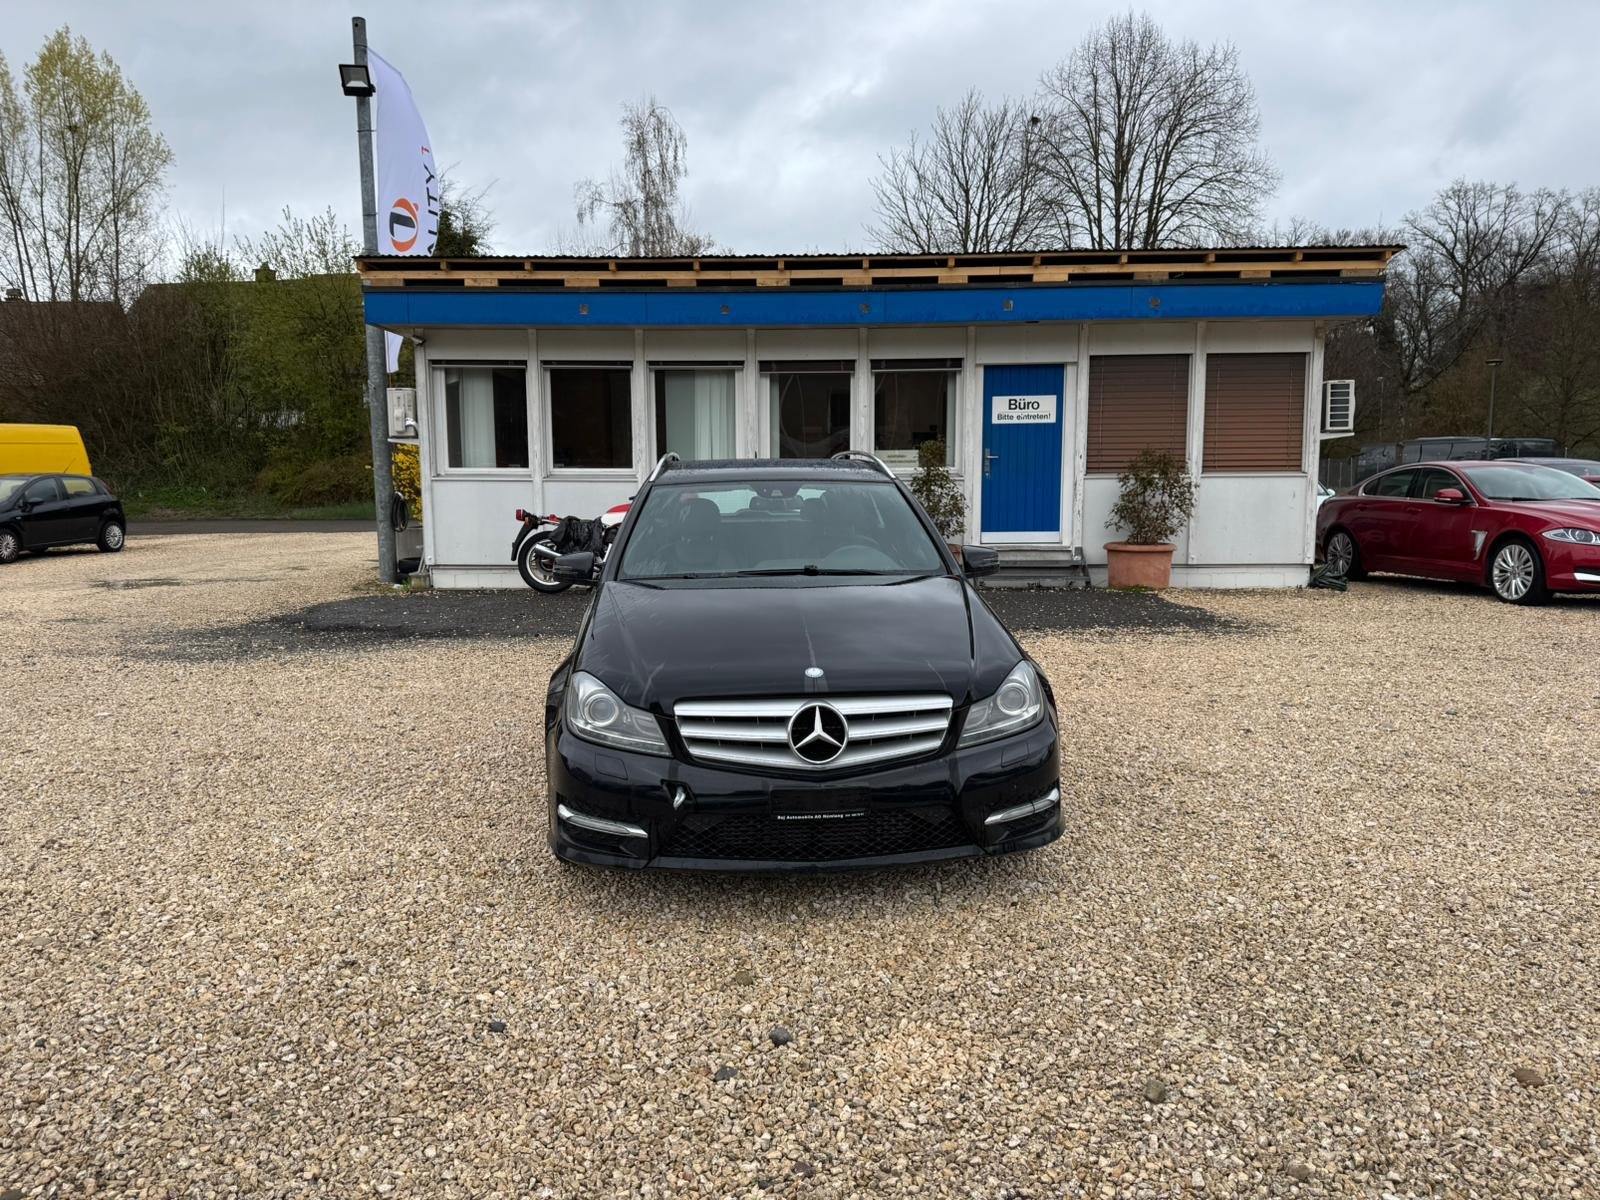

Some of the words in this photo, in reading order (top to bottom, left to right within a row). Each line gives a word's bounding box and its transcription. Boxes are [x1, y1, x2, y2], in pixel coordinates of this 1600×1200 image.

[1008, 398, 1040, 411] Büro
[997, 413, 1014, 421] Bitte
[1016, 412, 1051, 420] eintreten!
